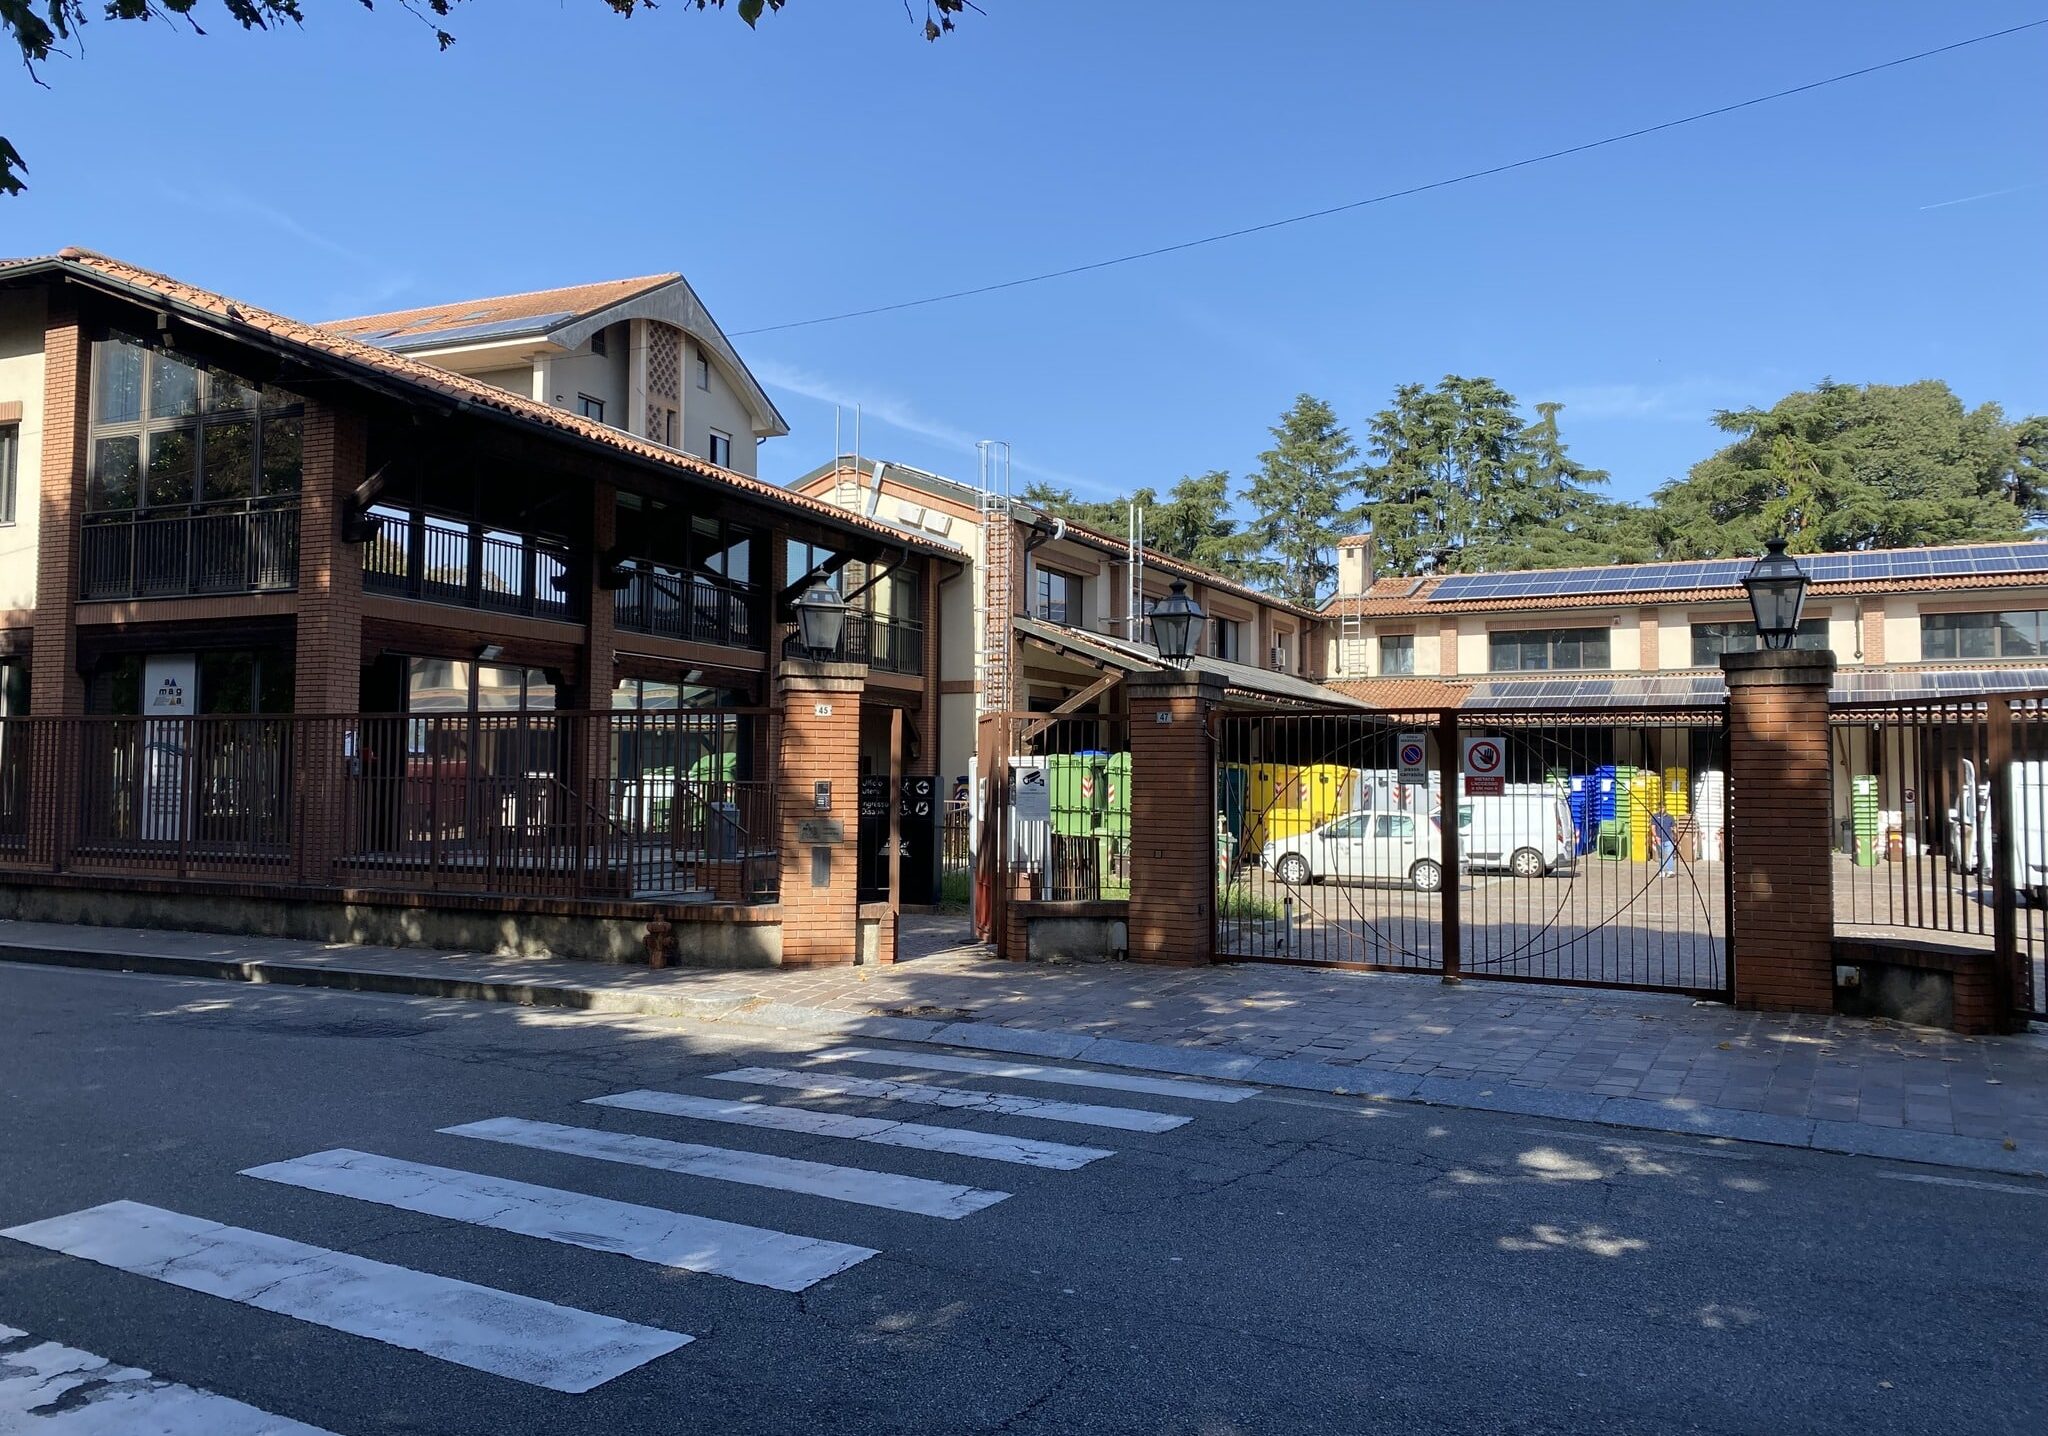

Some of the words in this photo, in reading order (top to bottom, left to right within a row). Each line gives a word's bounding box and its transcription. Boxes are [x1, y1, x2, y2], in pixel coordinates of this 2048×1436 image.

[818, 706, 829, 715] 45
[1159, 713, 1169, 721] 47
[861, 779, 883, 787] Uffico
